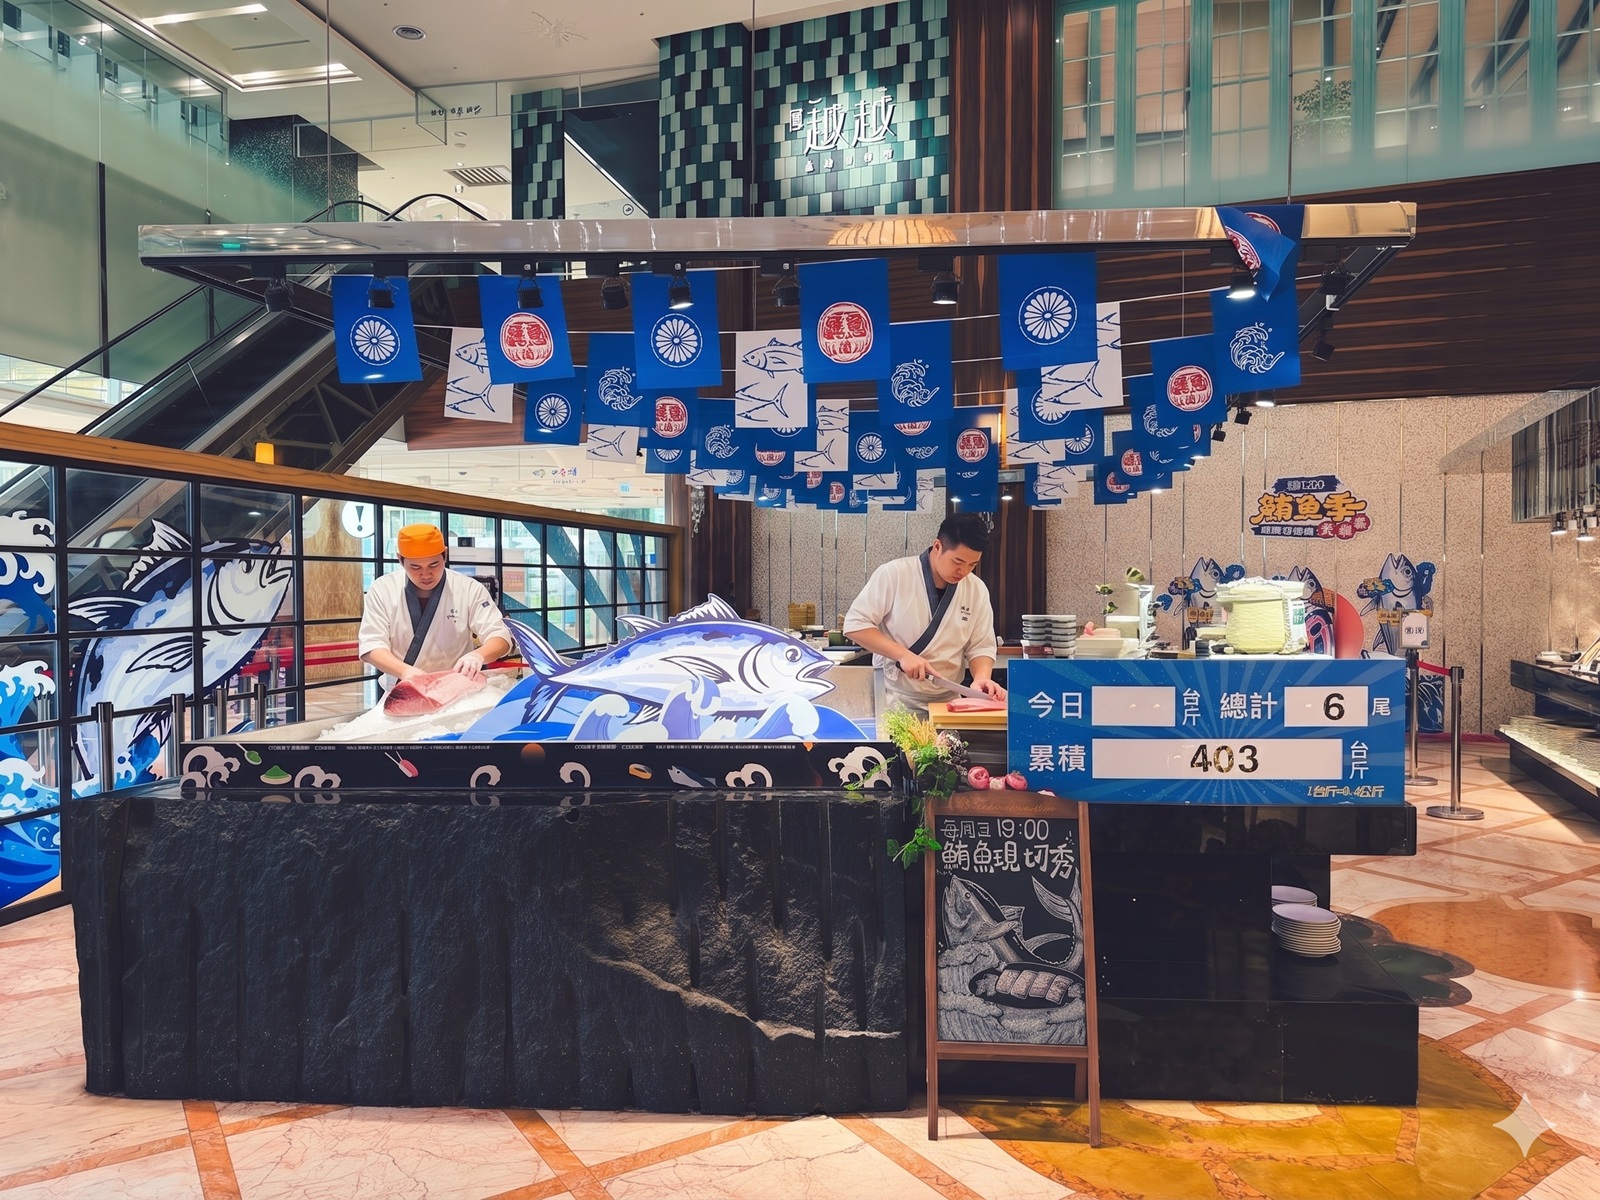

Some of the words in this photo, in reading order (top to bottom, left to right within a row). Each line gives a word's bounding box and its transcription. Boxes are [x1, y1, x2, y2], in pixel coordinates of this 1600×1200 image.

[1028, 691, 1083, 719] 今日
[1182, 687, 1201, 726] 台斤
[1220, 692, 1278, 720] 總計
[1323, 692, 1345, 720] 6
[1371, 697, 1391, 717] 尾
[1029, 744, 1086, 772] 累積
[1190, 744, 1259, 774] 403
[1349, 741, 1369, 779] 台斤
[942, 840, 1075, 879] 鮪魚現切秀
